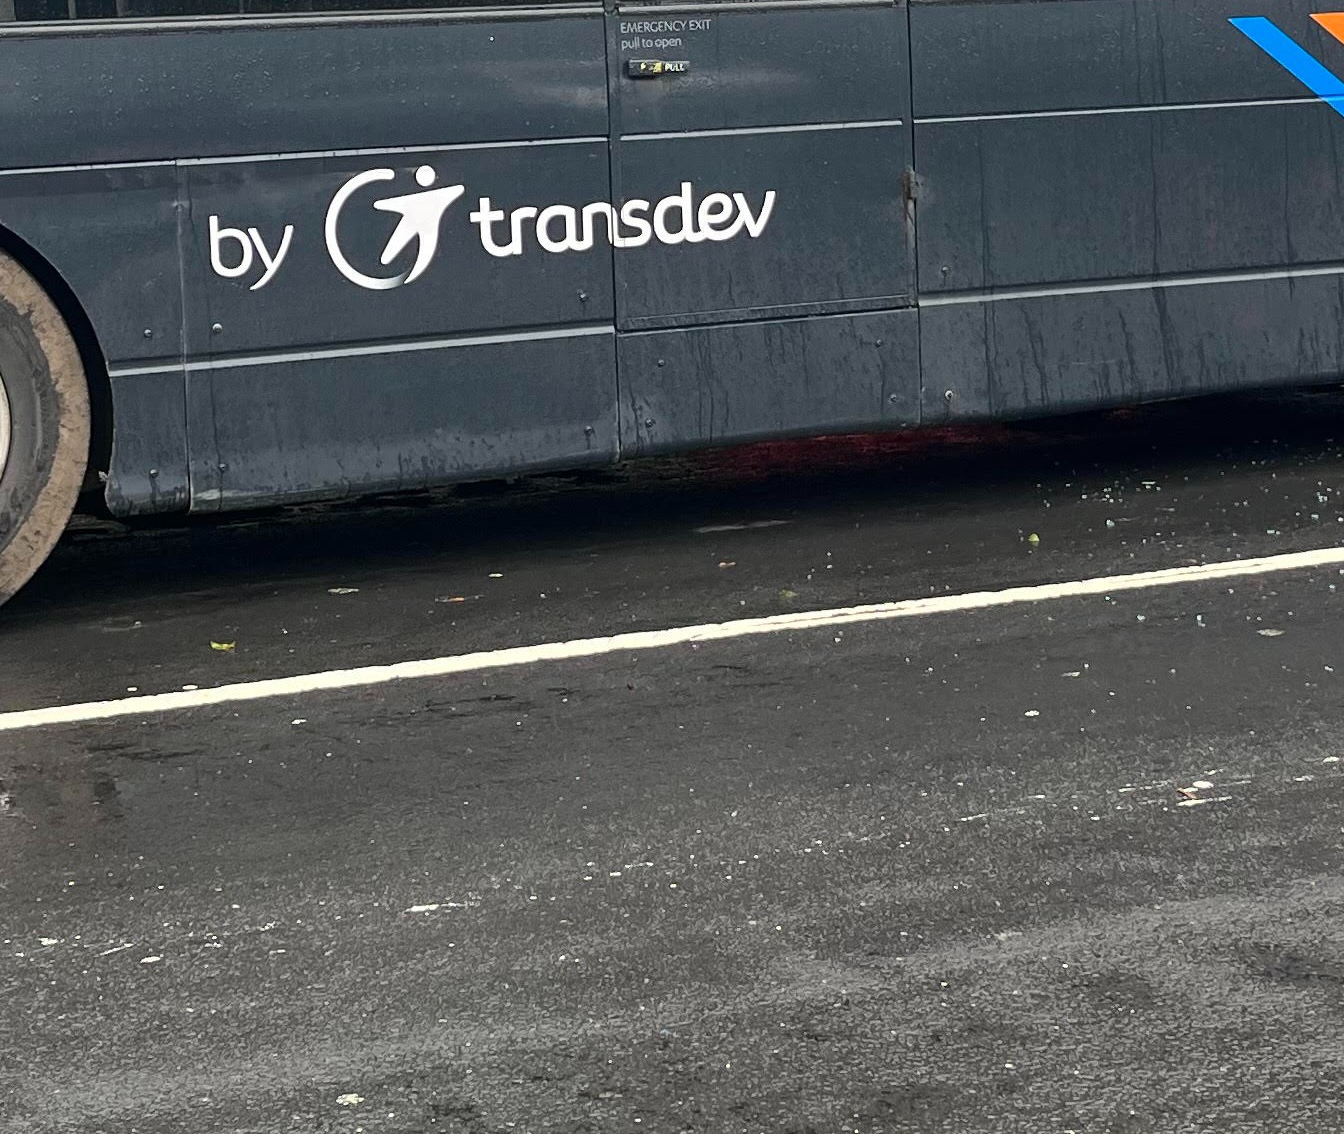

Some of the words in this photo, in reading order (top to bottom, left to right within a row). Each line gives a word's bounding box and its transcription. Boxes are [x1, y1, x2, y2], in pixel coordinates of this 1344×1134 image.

[620, 21, 687, 34] EMERGENCY
[688, 19, 712, 31] EXIT
[621, 37, 641, 51] pull
[642, 38, 654, 48] to
[654, 37, 683, 50] open
[209, 216, 294, 290] by
[470, 181, 776, 257] transdev
